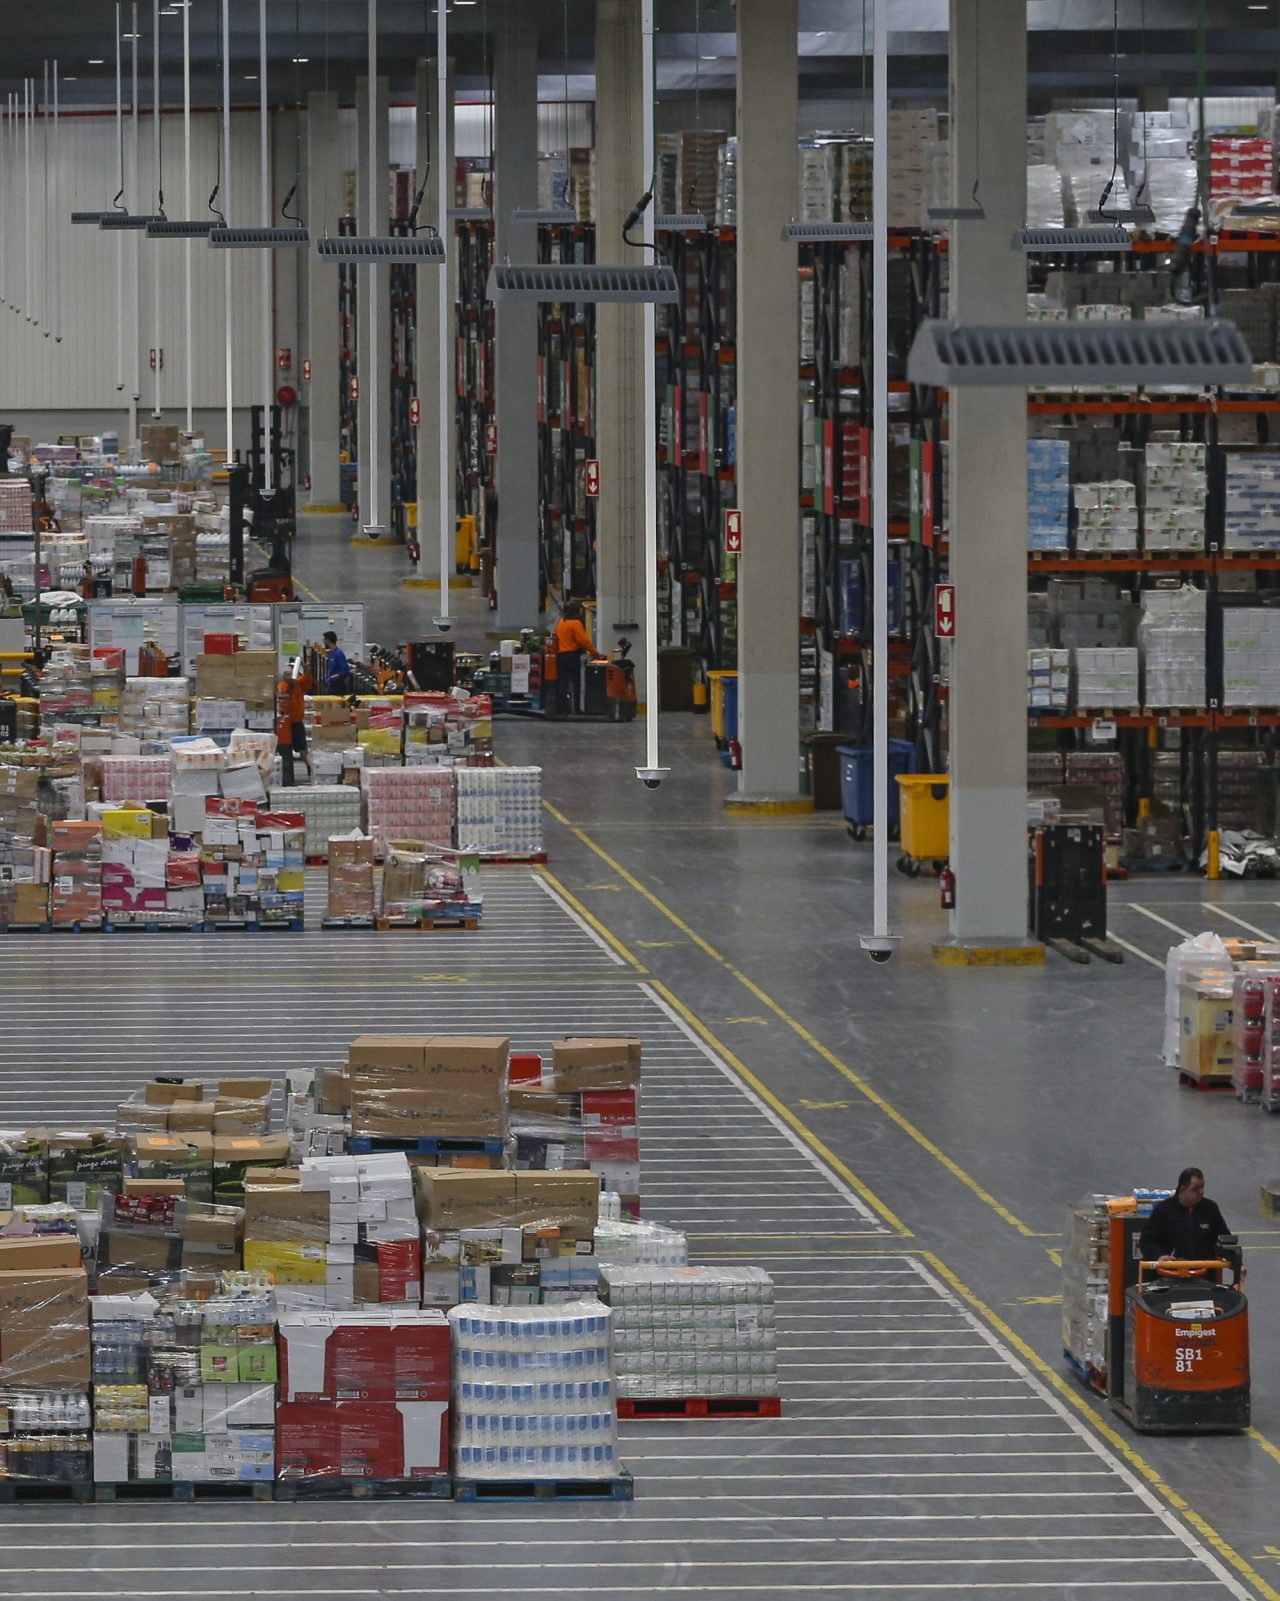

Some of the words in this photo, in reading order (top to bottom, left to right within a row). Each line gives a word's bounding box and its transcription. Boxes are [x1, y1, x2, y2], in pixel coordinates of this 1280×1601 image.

[1175, 1328, 1216, 1338] Empigest
[1175, 1348, 1202, 1360] SB1
[1175, 1360, 1193, 1372] 81
